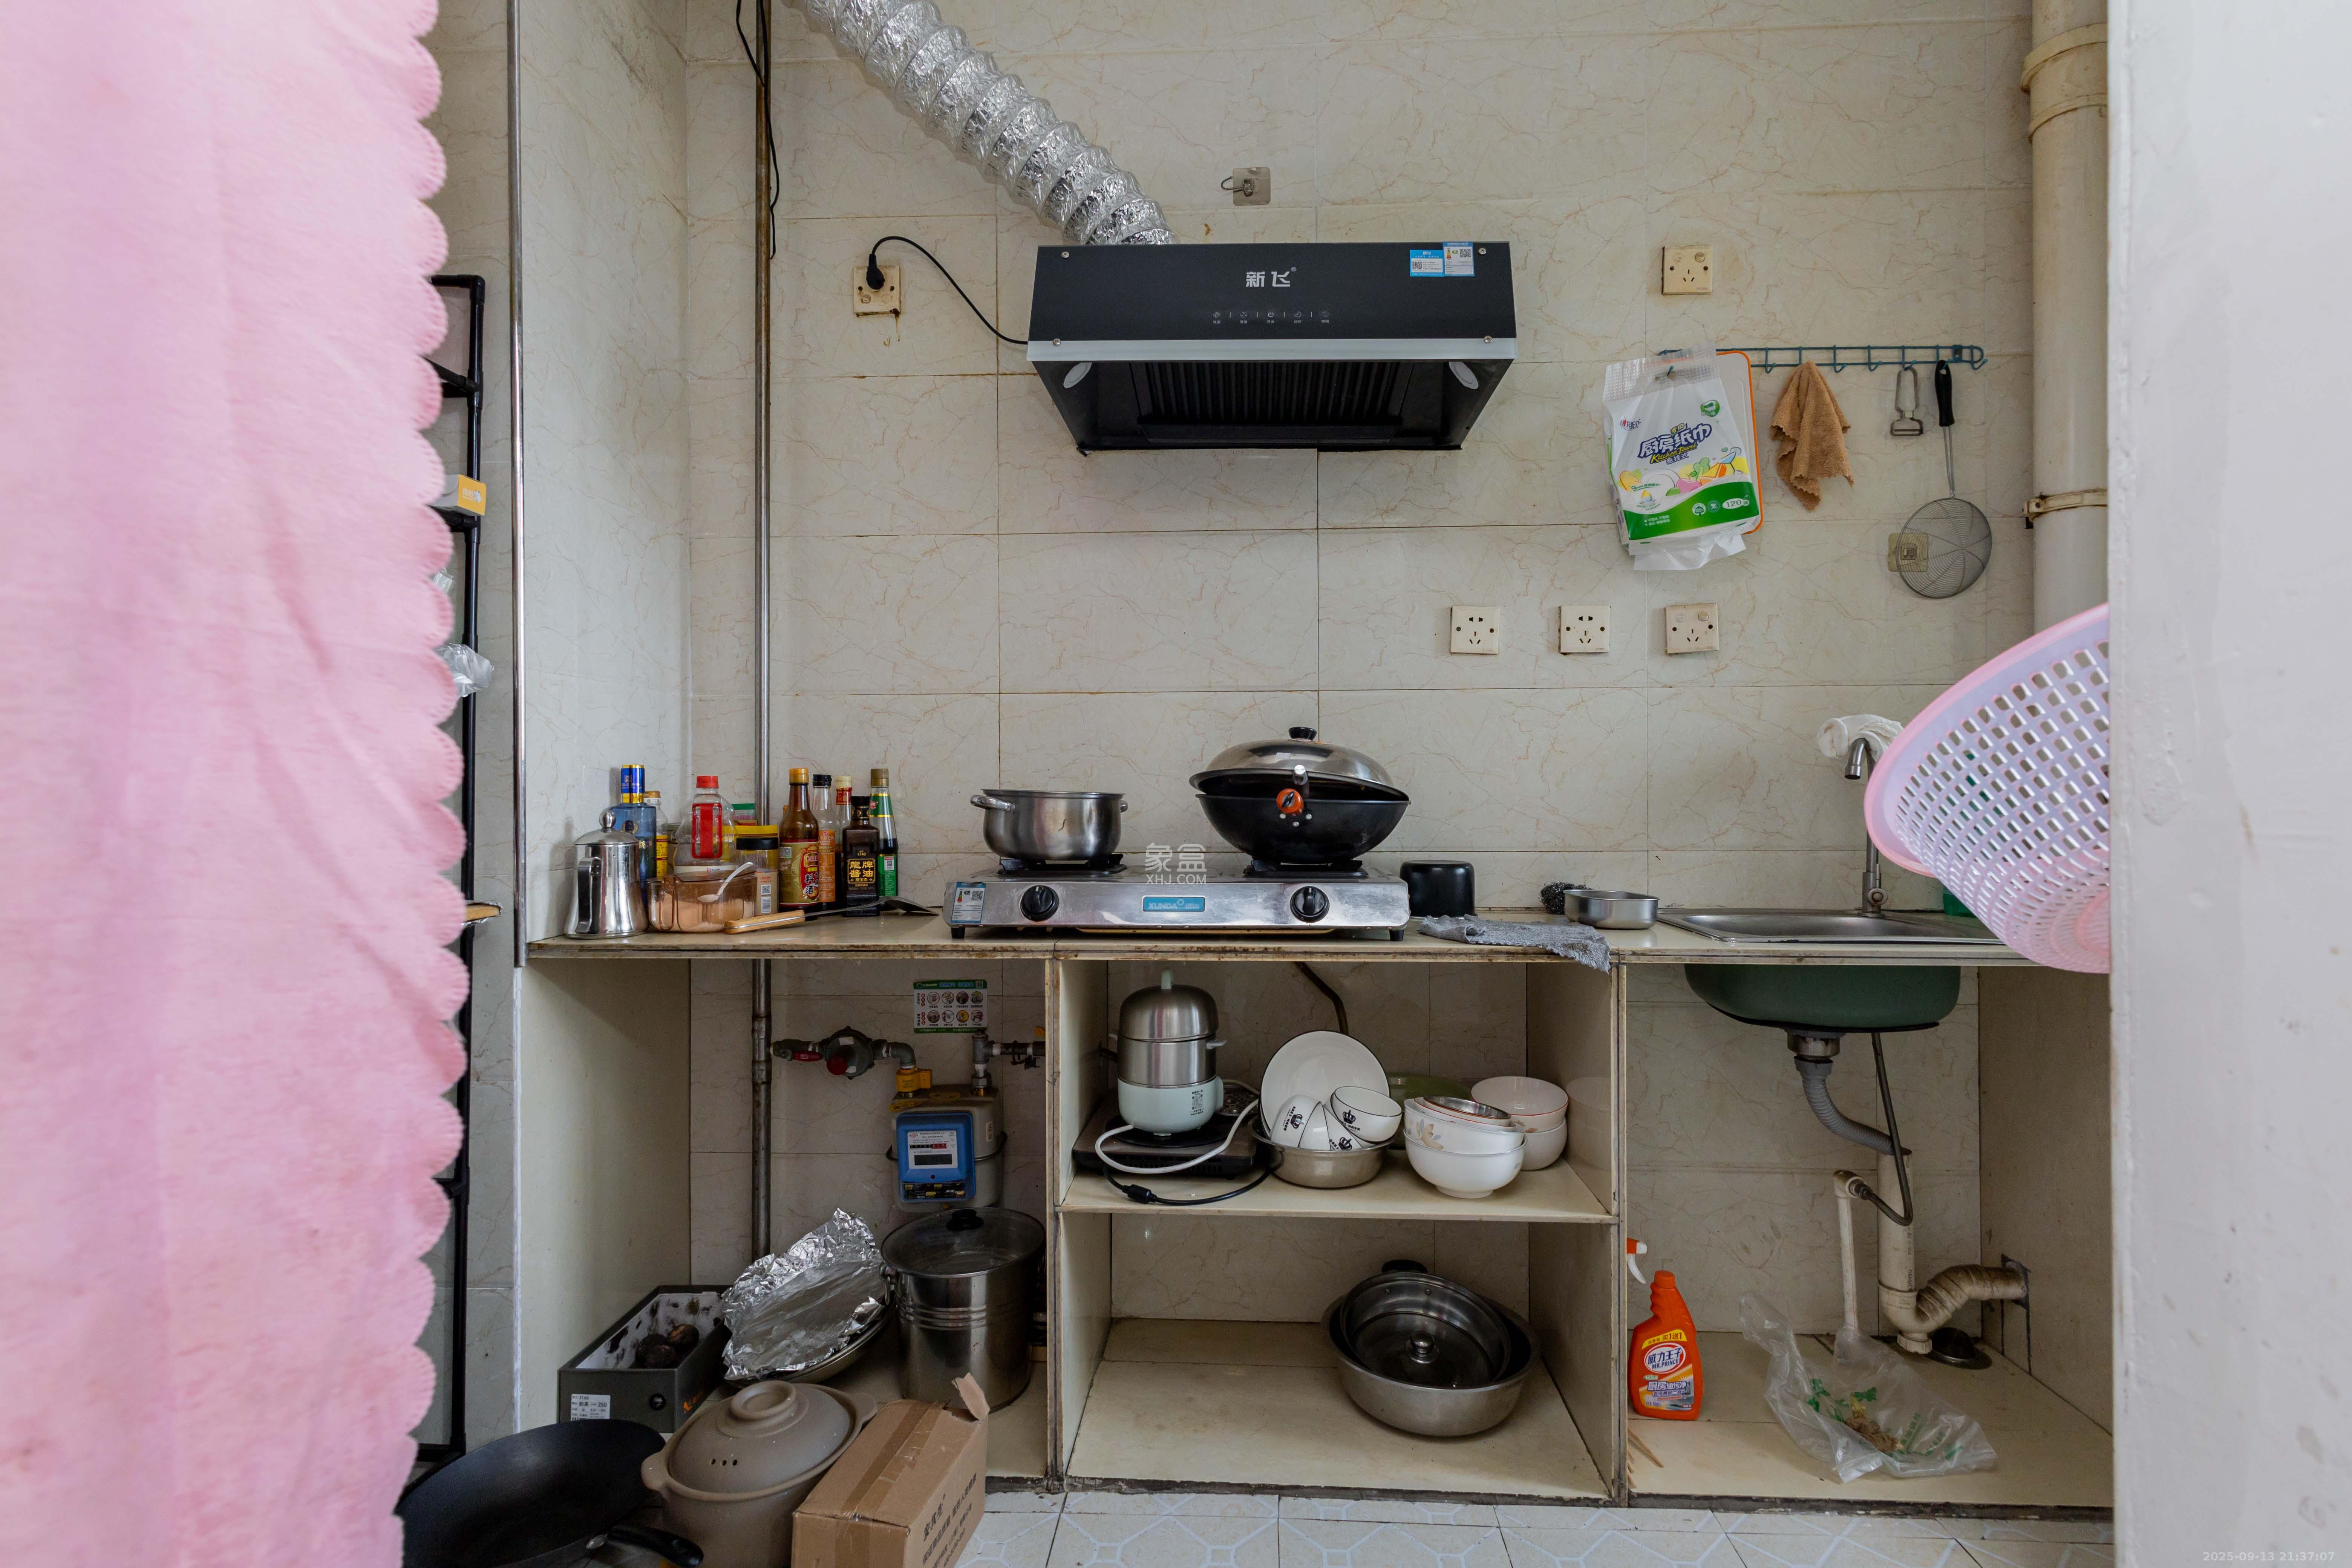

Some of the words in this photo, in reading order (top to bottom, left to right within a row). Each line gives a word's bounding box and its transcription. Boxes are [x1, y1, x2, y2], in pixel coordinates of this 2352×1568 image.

[1246, 271, 1291, 287] 新飞
[1671, 423, 1685, 433] 专用
[1638, 423, 1712, 458] 厨房纸巾
[1650, 451, 1677, 464] Kitchen
[1677, 442, 1698, 455] Towel
[1648, 1348, 1681, 1364] 威力王子
[1652, 1358, 1679, 1369] MR.PRINCE
[1648, 1381, 1687, 1391] 厨房油污净
